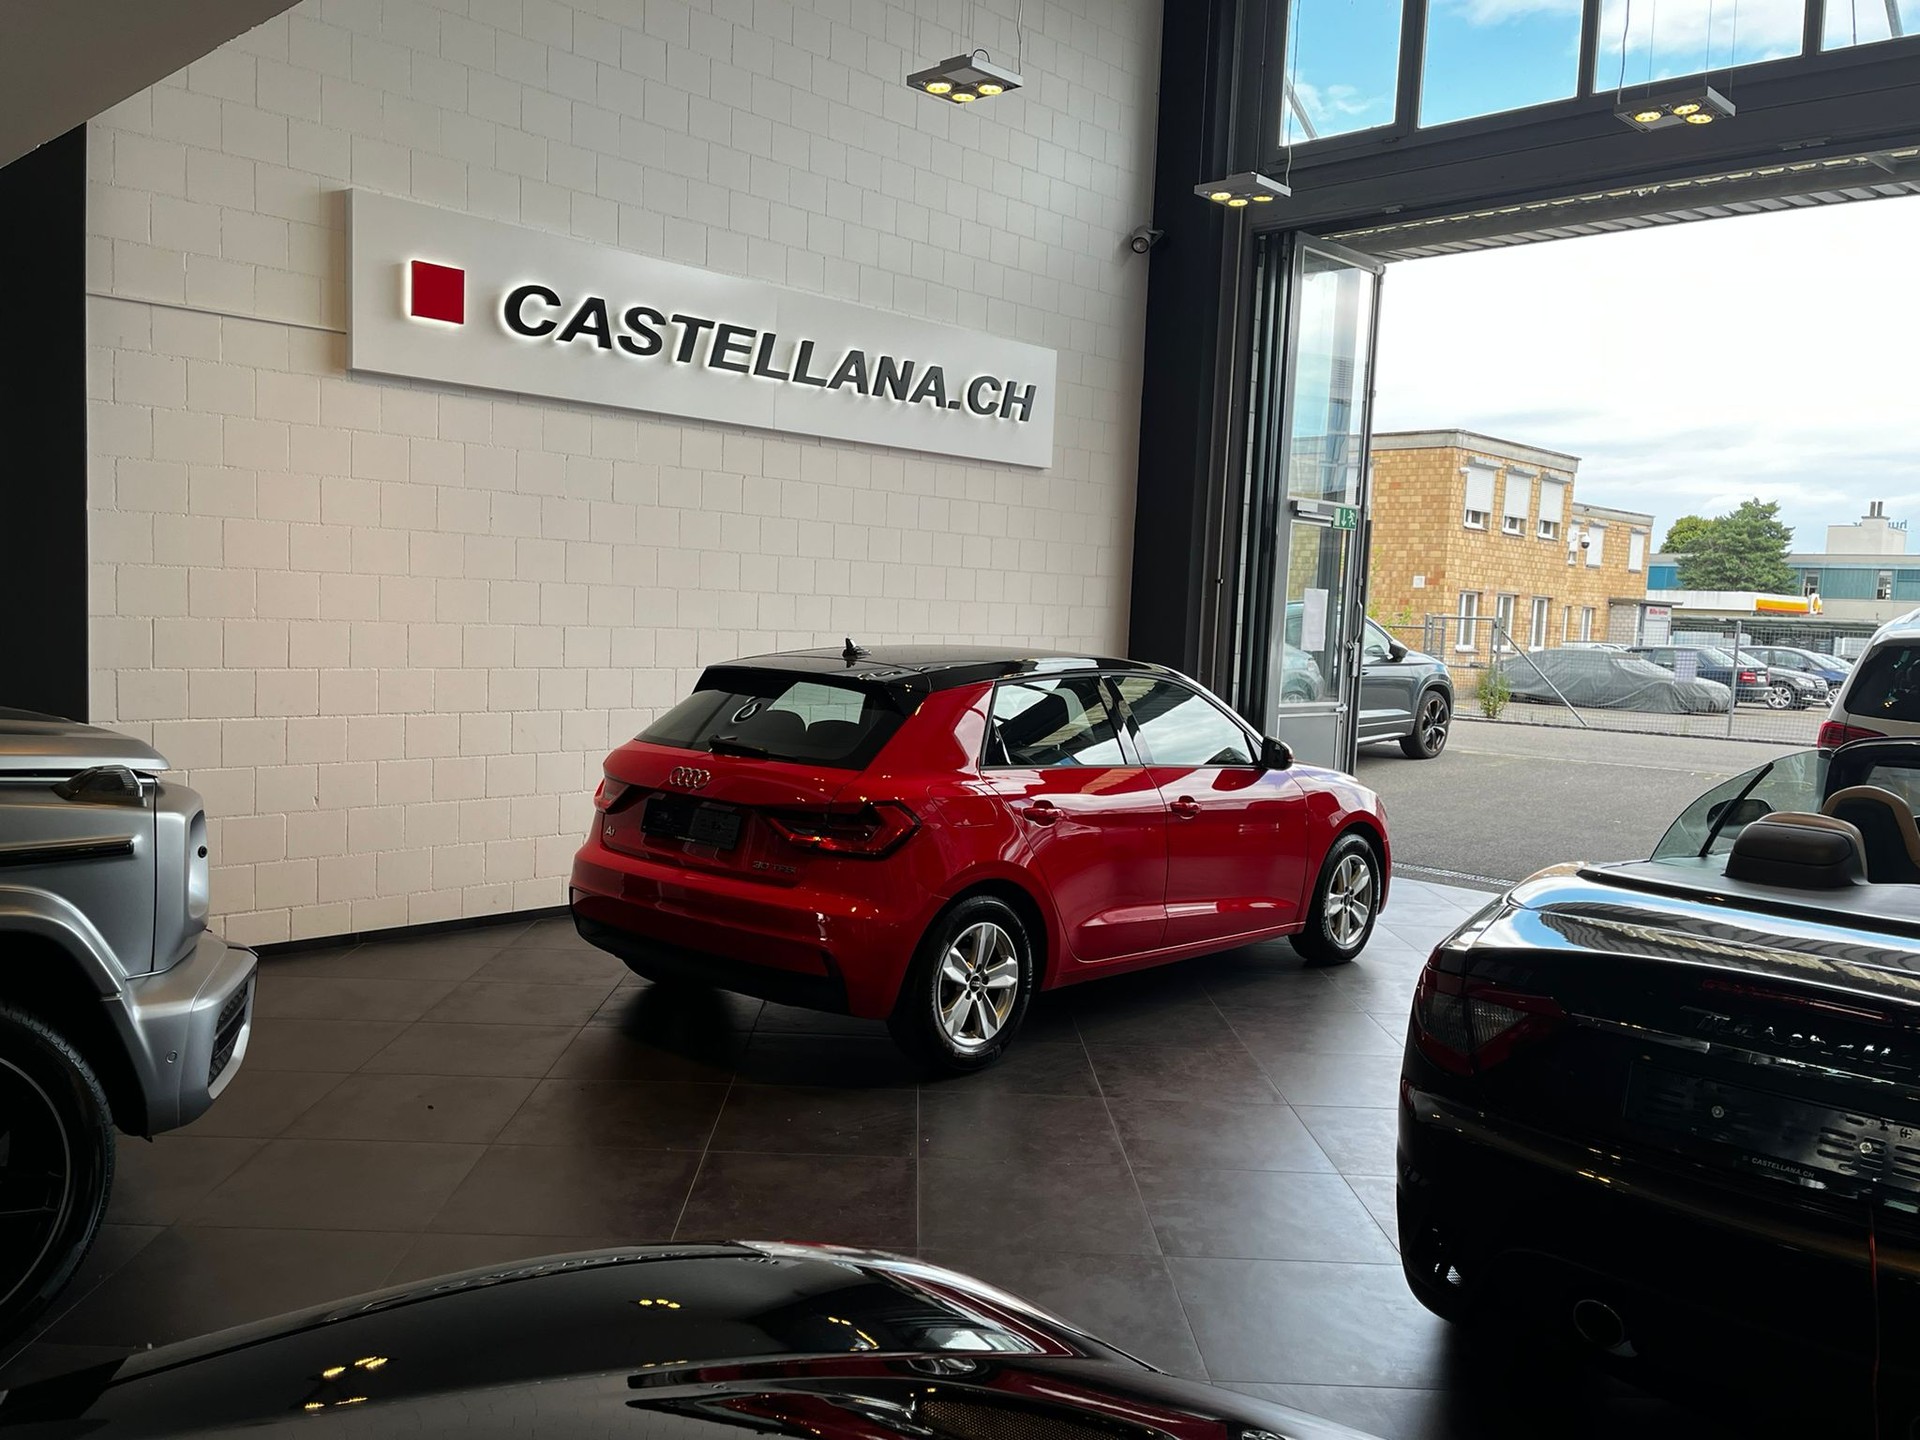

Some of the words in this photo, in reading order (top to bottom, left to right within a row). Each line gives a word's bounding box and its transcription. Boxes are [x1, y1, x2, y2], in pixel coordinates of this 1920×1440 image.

[503, 285, 1036, 422] CASTELLANA.CH
[604, 825, 615, 836] A1
[1751, 1157, 1815, 1178] CASTELLANA.CH
